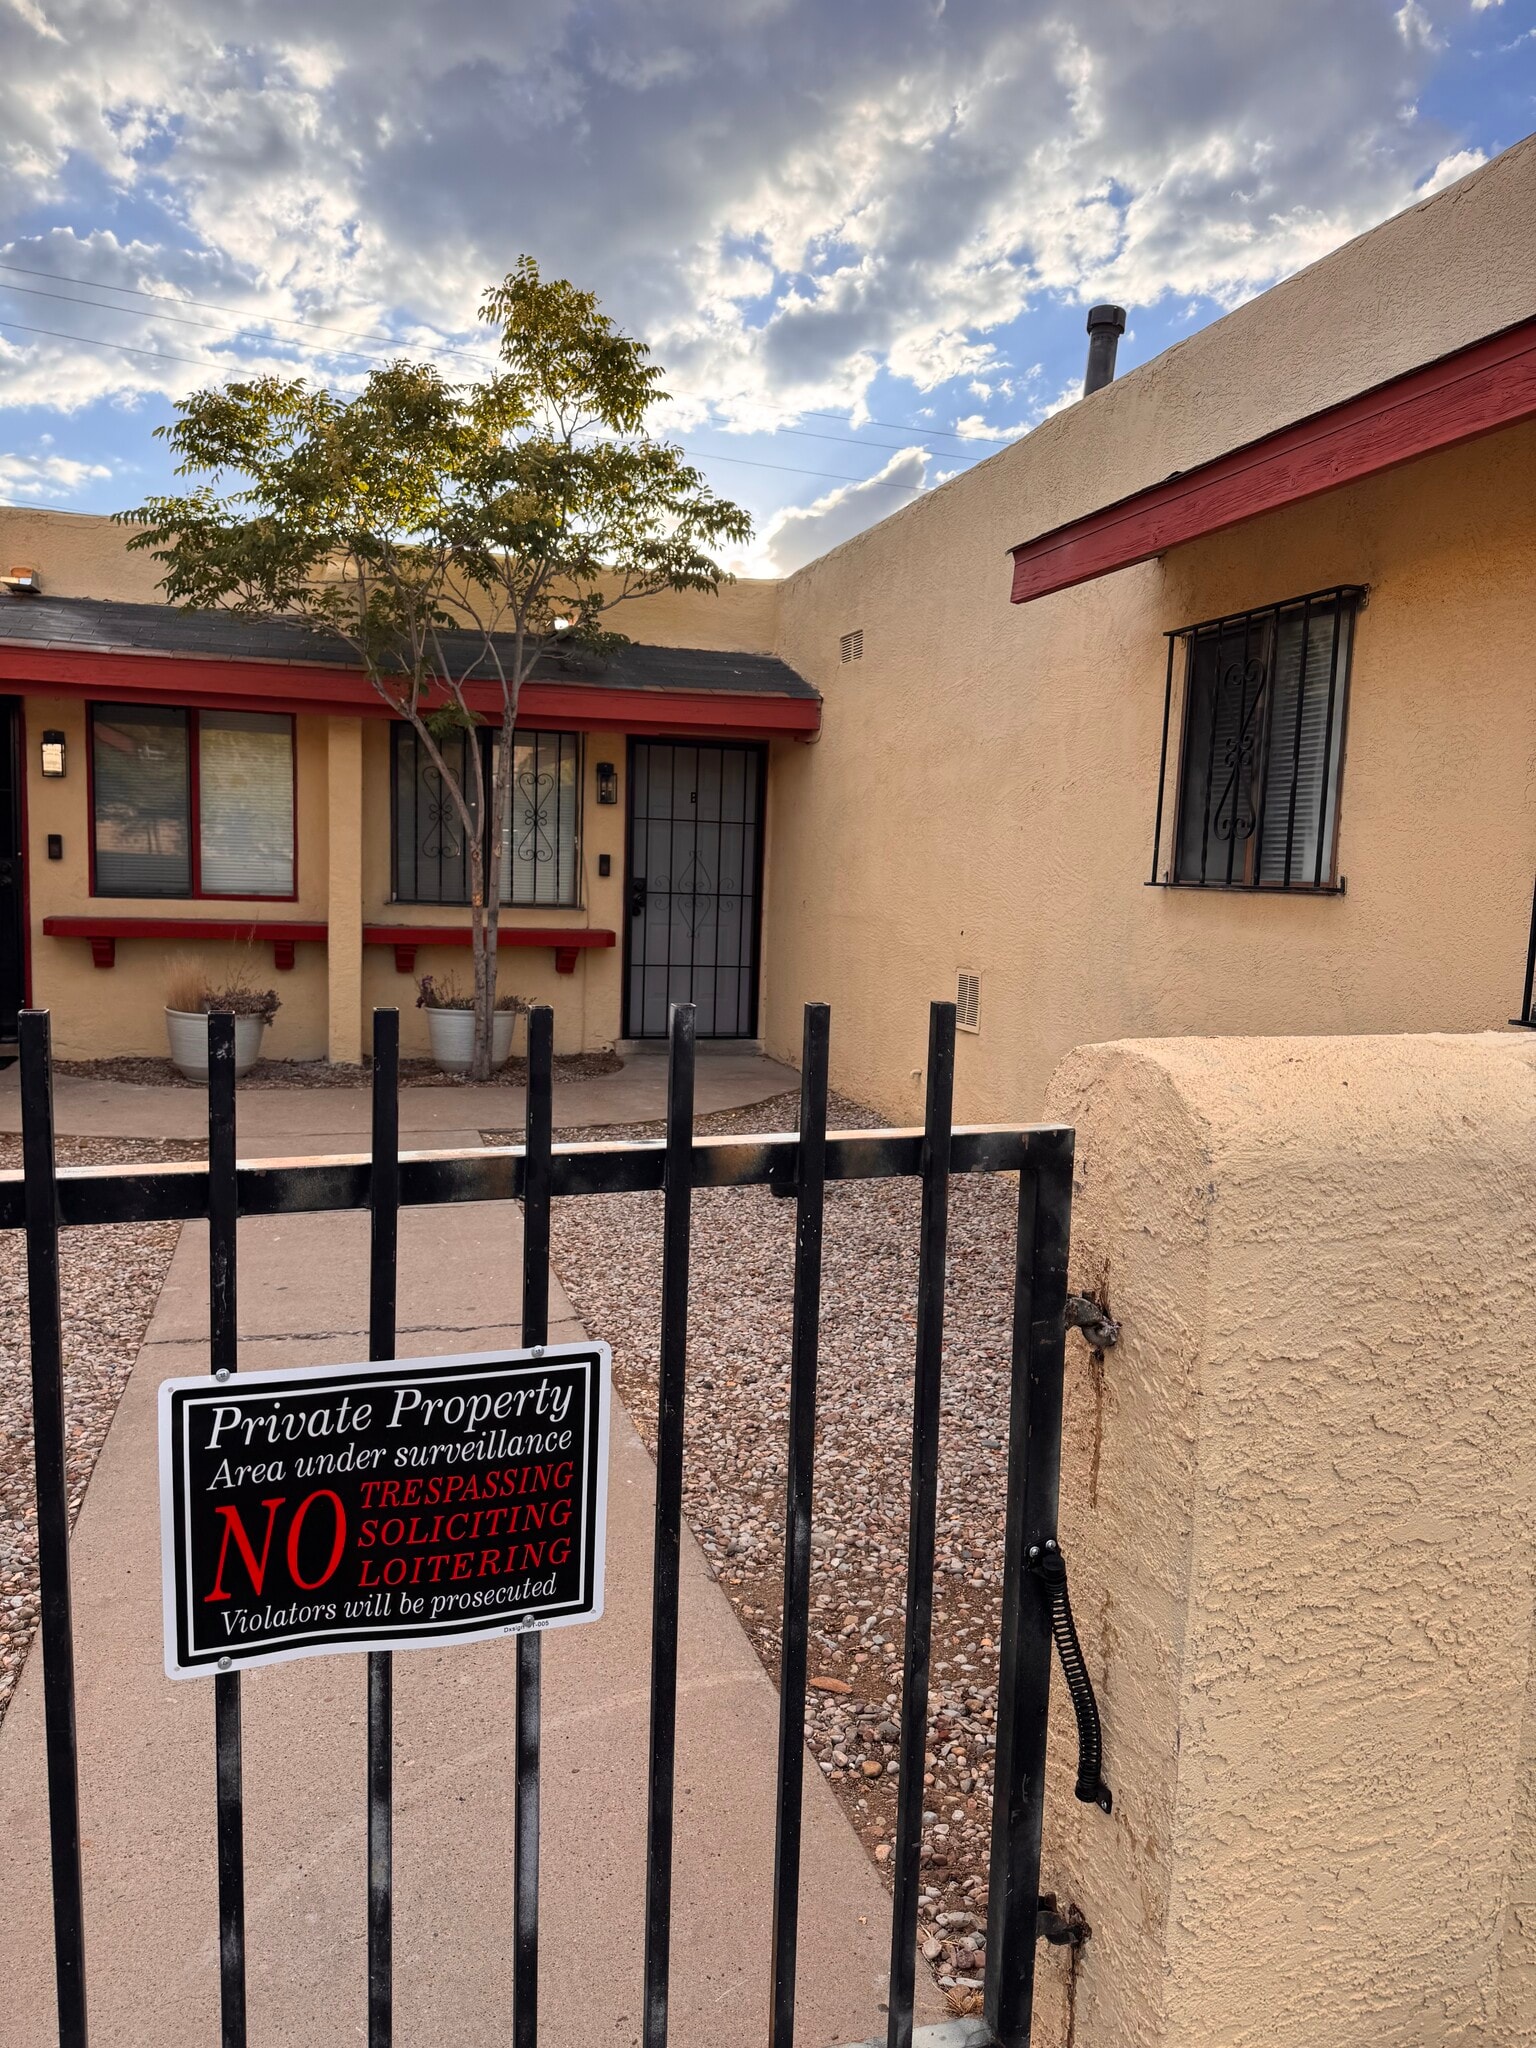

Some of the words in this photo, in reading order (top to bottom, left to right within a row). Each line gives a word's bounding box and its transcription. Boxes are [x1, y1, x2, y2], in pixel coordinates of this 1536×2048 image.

[204, 1397, 372, 1450] Private
[386, 1378, 573, 1433] Property
[206, 1459, 286, 1491] Area
[295, 1443, 386, 1477] under
[394, 1429, 572, 1467] surveillance
[360, 1461, 574, 1509] TRESPASSING
[204, 1489, 347, 1602] NO
[358, 1499, 572, 1547] SOLICITING
[358, 1538, 571, 1587] LOITERING
[221, 1602, 337, 1635] Violators
[344, 1593, 391, 1618] will
[400, 1593, 424, 1616] be
[431, 1572, 556, 1619] prosecuted
